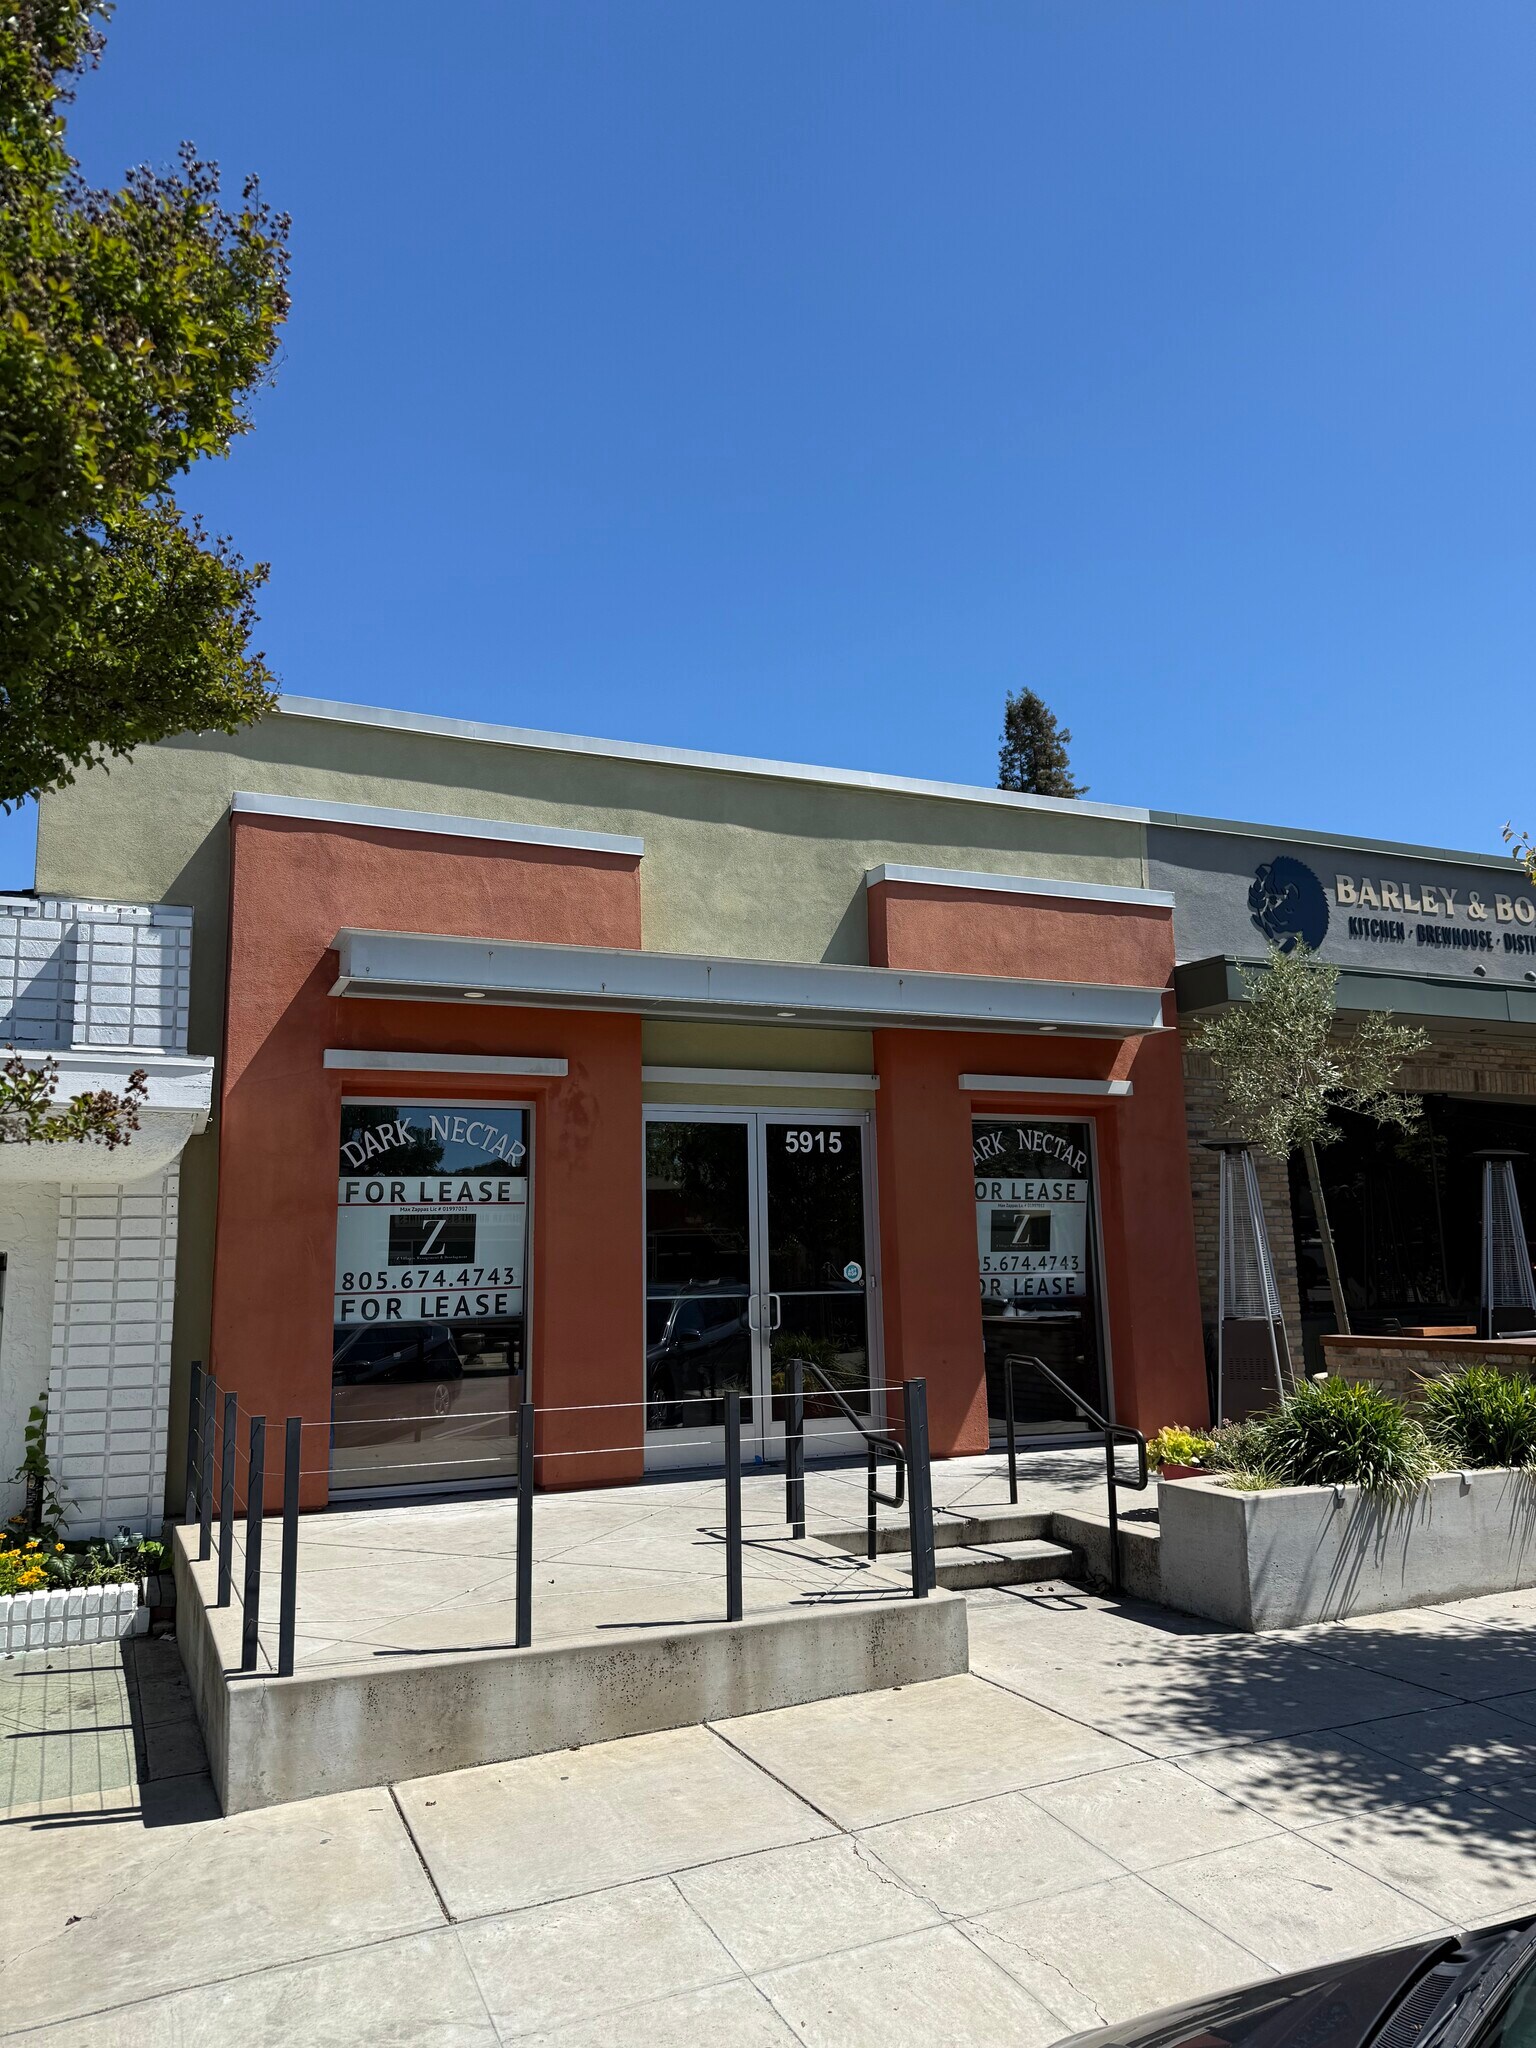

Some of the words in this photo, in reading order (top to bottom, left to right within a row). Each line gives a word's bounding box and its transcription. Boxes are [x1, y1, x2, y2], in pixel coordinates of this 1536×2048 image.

[1335, 874, 1458, 917] BARLEY
[1467, 891, 1489, 920] &
[1494, 893, 1536, 925] BO
[1349, 916, 1405, 941] KITCHEN
[1416, 923, 1494, 949] BREWHOUSE
[1503, 932, 1536, 955] DISTI
[340, 1117, 417, 1169] DARK
[428, 1115, 527, 1168] NECTAR
[785, 1130, 842, 1154] 5915
[972, 1130, 1007, 1167] ARK
[1016, 1128, 1087, 1174] NECTAR
[345, 1181, 407, 1203] FOR
[419, 1180, 511, 1203] LEASE
[975, 1181, 1003, 1201] OR
[1011, 1182, 1076, 1201] LEASE
[419, 1219, 447, 1256] Z
[1011, 1213, 1031, 1244] Z
[983, 1255, 1079, 1272] 5.674.4743
[341, 1267, 515, 1291] 805.674.4743
[979, 1278, 1002, 1297] OR
[1014, 1277, 1076, 1296] LEASE
[341, 1297, 403, 1322] FOR
[420, 1294, 508, 1319] LEASE
